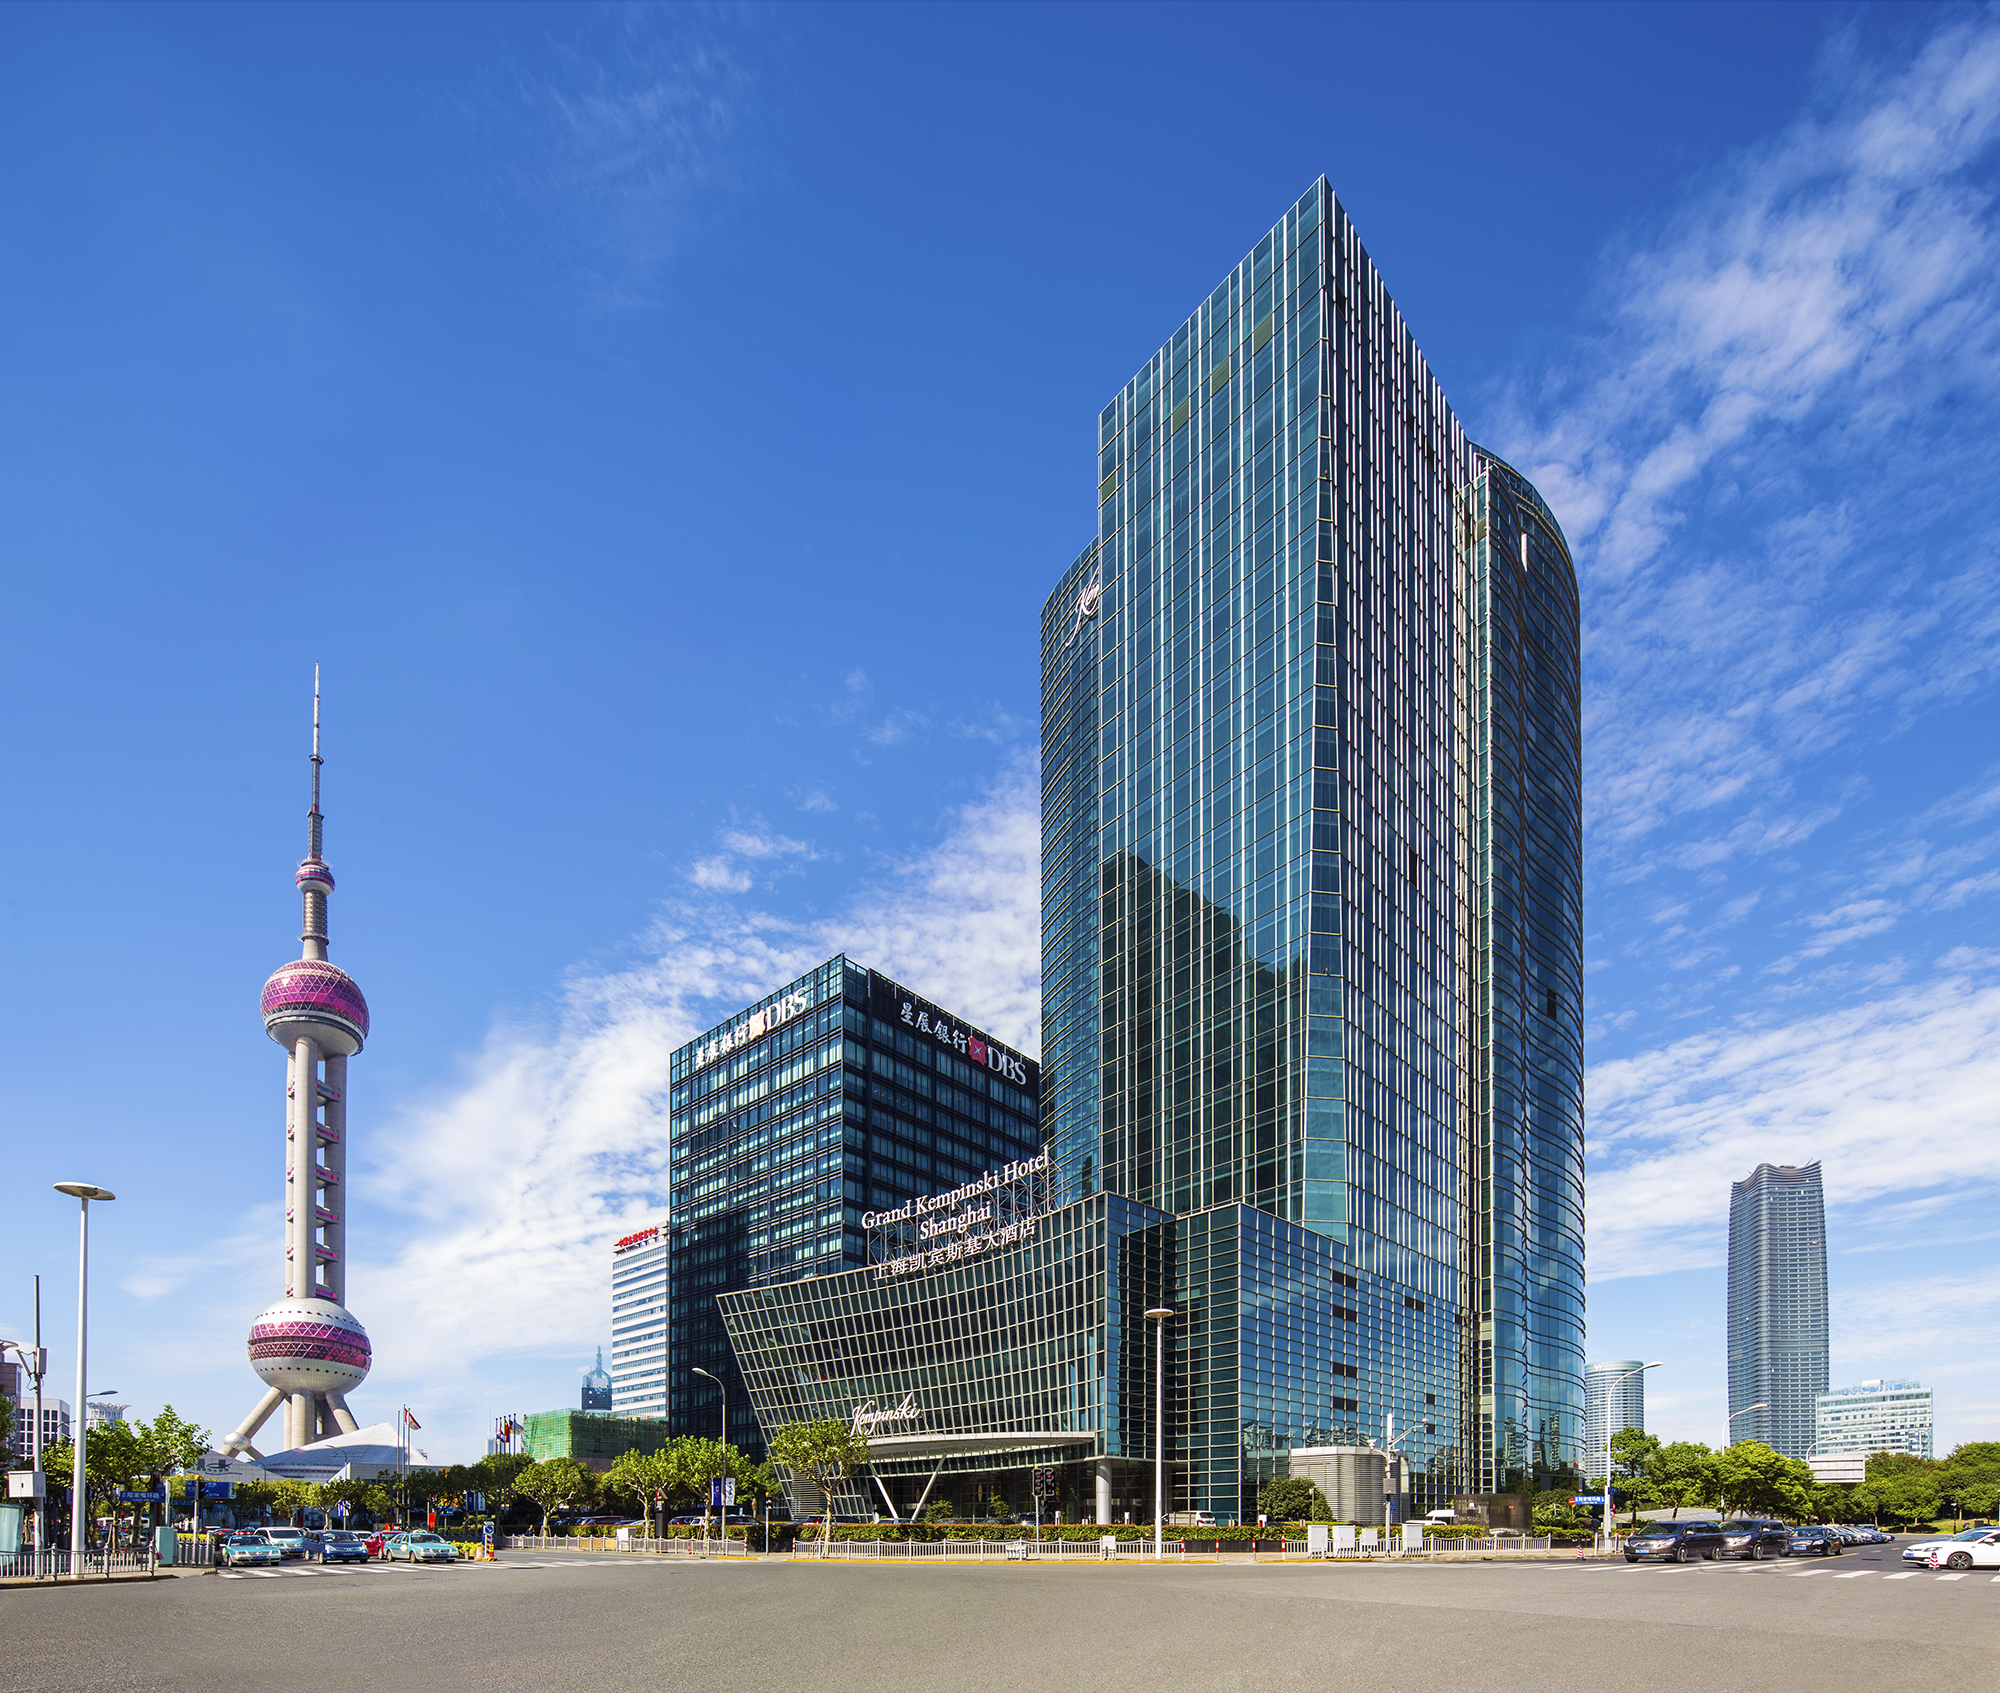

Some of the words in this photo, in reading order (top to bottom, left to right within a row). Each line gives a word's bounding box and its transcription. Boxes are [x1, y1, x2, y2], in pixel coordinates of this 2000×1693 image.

[766, 987, 807, 1031] DBS
[987, 1045, 1026, 1085] DBS
[861, 1199, 911, 1230] Grand
[915, 1169, 999, 1211] Kempinski
[1002, 1144, 1049, 1184] Hotel
[920, 1200, 991, 1240] Shanghai
[873, 1215, 1037, 1280] 上海凯宾斯基大酒店
[849, 1391, 921, 1437] Kempinski
